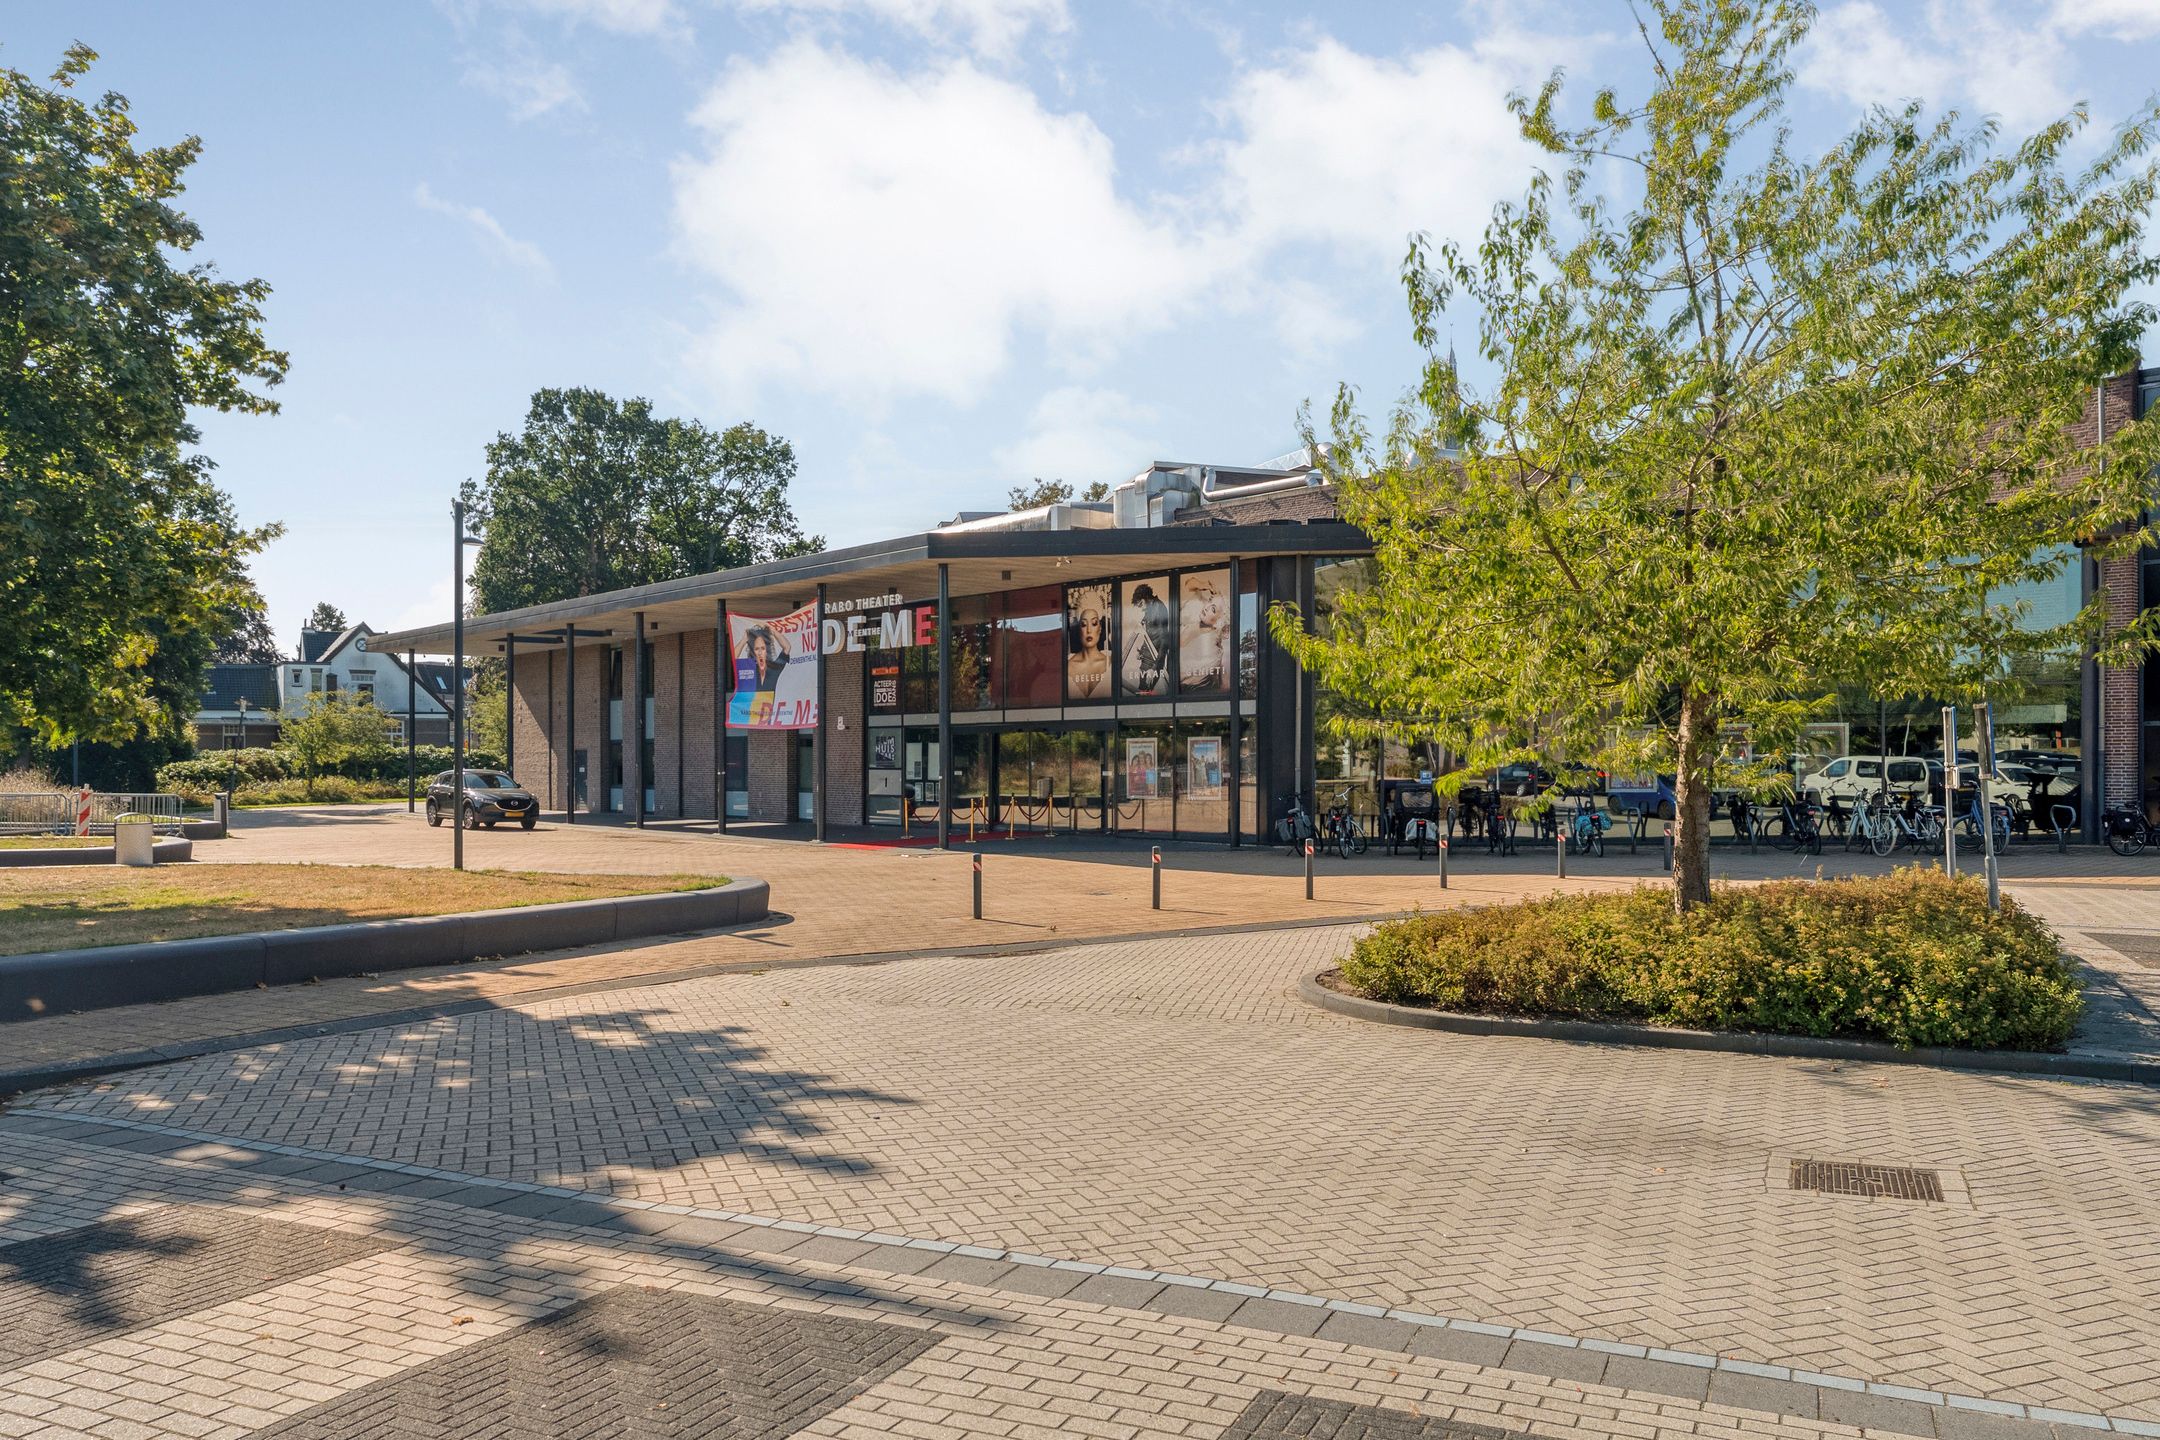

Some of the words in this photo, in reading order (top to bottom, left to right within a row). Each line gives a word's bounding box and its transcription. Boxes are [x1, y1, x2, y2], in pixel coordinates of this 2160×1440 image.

[825, 600, 854, 614] RABO
[855, 593, 903, 610] THEATER
[768, 608, 818, 634] BESTEL
[823, 615, 867, 655] DE
[880, 606, 936, 650] ME
[801, 631, 818, 653] NU
[1129, 669, 1165, 680] ERVAAR
[1186, 665, 1225, 677] GENIET!
[1075, 673, 1105, 683] BELEEF
[877, 692, 893, 703] DOE
[875, 744, 895, 753] HUIS
